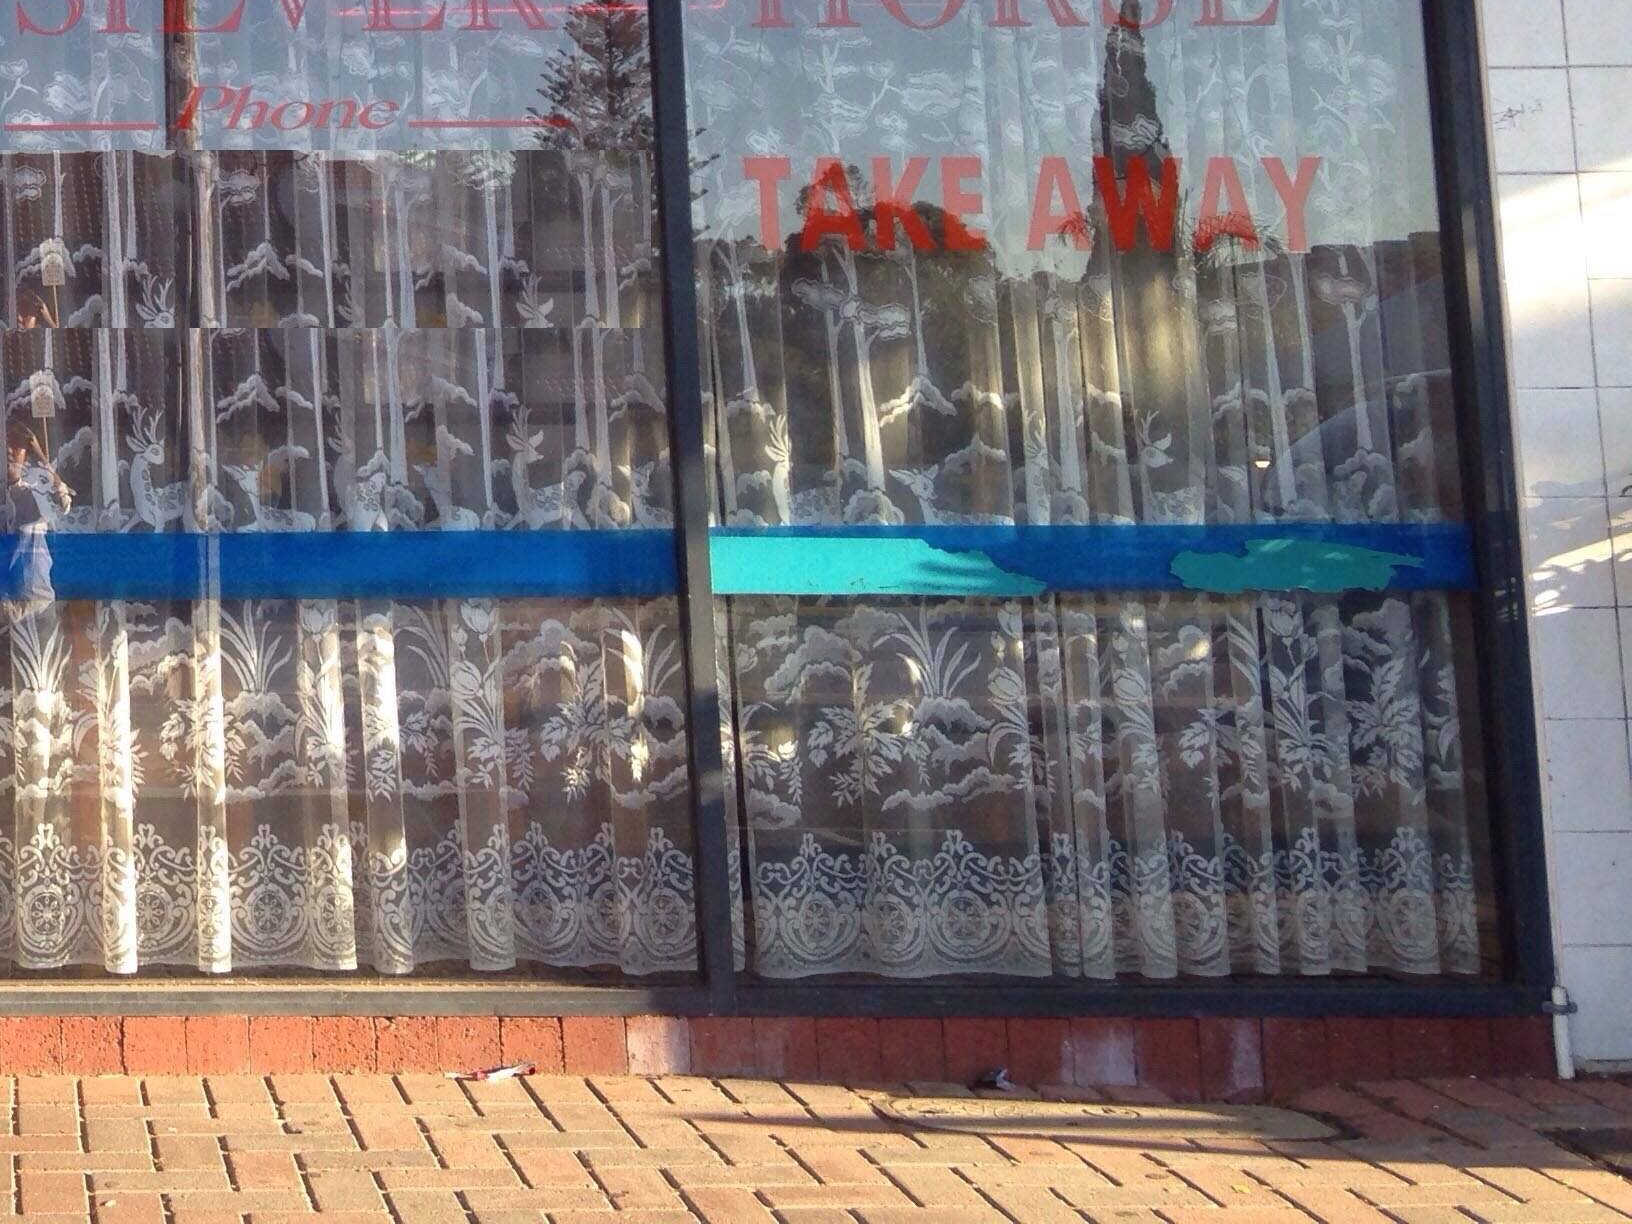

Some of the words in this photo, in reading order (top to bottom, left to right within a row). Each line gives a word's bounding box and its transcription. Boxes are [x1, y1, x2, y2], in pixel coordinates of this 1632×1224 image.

[176, 83, 400, 131] Phone
[742, 156, 989, 253] TAKE
[1026, 155, 1322, 254] AWAY
